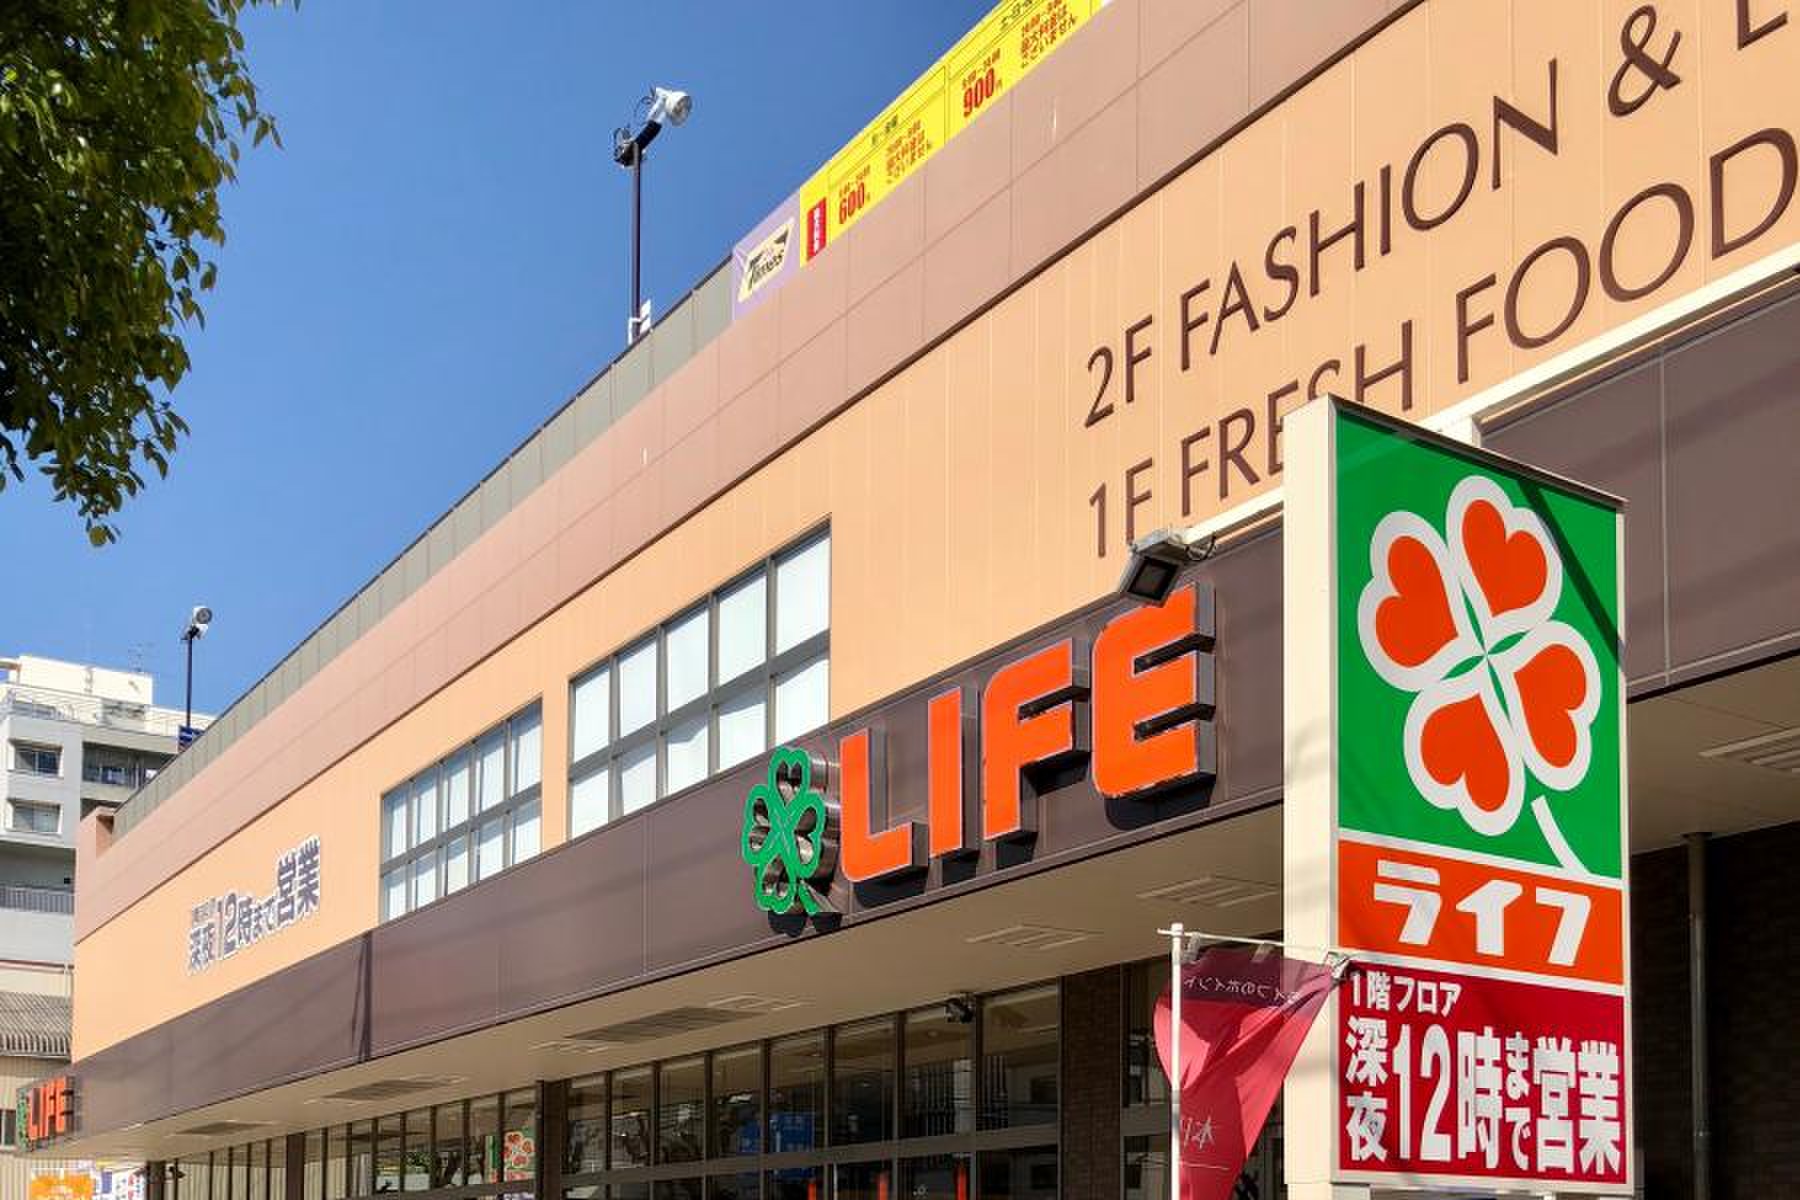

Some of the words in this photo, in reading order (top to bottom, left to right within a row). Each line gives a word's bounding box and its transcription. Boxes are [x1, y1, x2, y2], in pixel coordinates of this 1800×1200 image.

[1084, 314, 1153, 428] 2F
[1180, 57, 1558, 371] FASHION
[1607, 5, 1681, 117] &
[1089, 457, 1153, 558] 1F
[1456, 127, 1799, 385] FOOD
[839, 583, 1200, 883] LIFE
[1350, 970, 1462, 1018] 1階フロア
[1373, 859, 1592, 967] ライフ
[26, 1076, 67, 1140] LIFE
